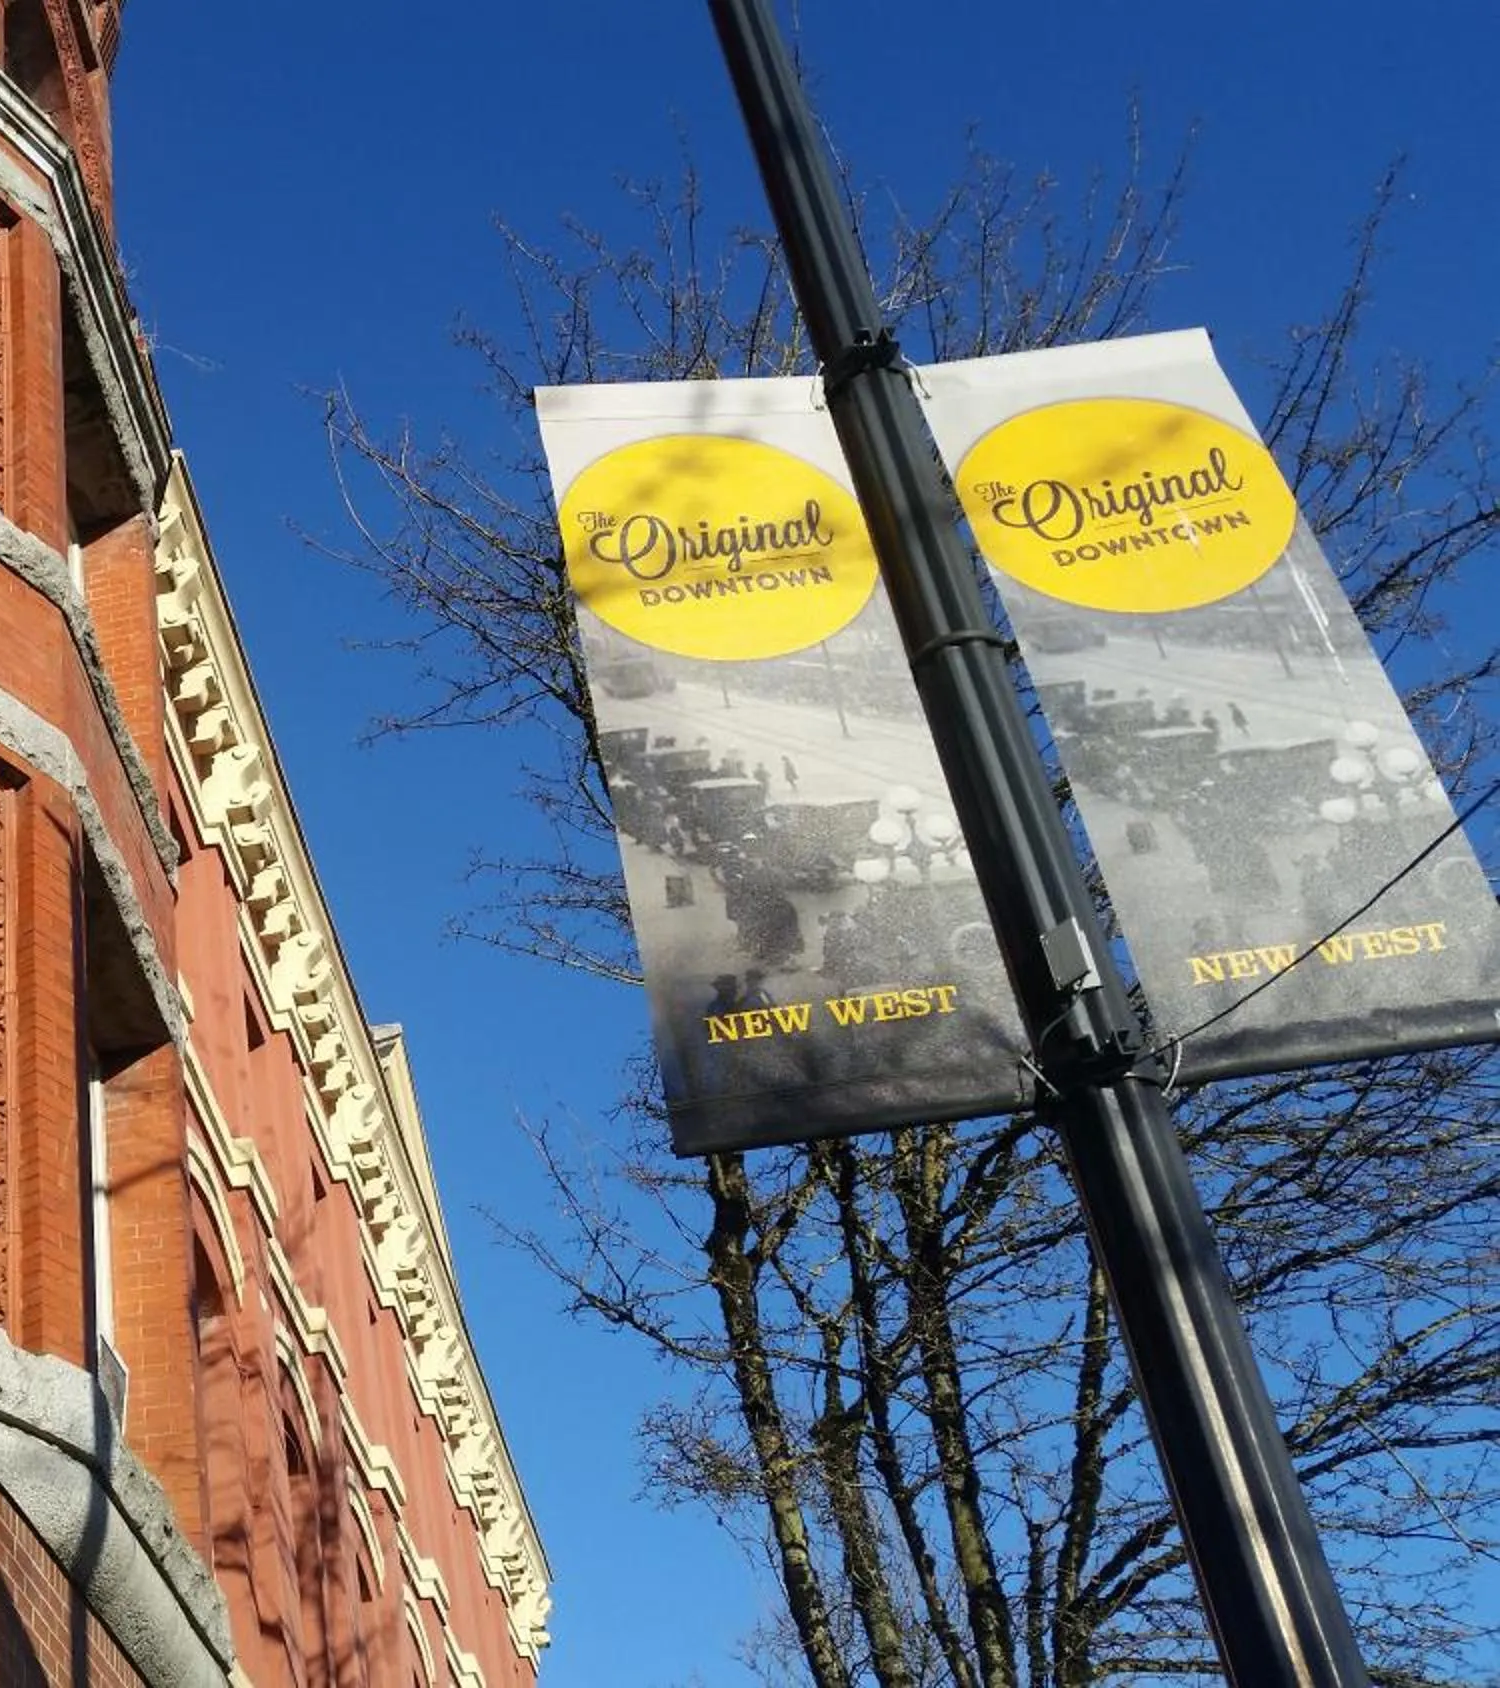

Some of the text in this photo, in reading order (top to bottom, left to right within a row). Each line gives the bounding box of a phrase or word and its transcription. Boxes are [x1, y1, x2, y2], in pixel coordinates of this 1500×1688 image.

[974, 447, 1244, 541] The Original
[577, 499, 835, 581] The Original
[1051, 510, 1252, 567] DOWNTOWN
[639, 565, 834, 607] DOWNTOWN
[1187, 920, 1447, 986] NEW WEST
[703, 985, 958, 1044] NEW WEST
